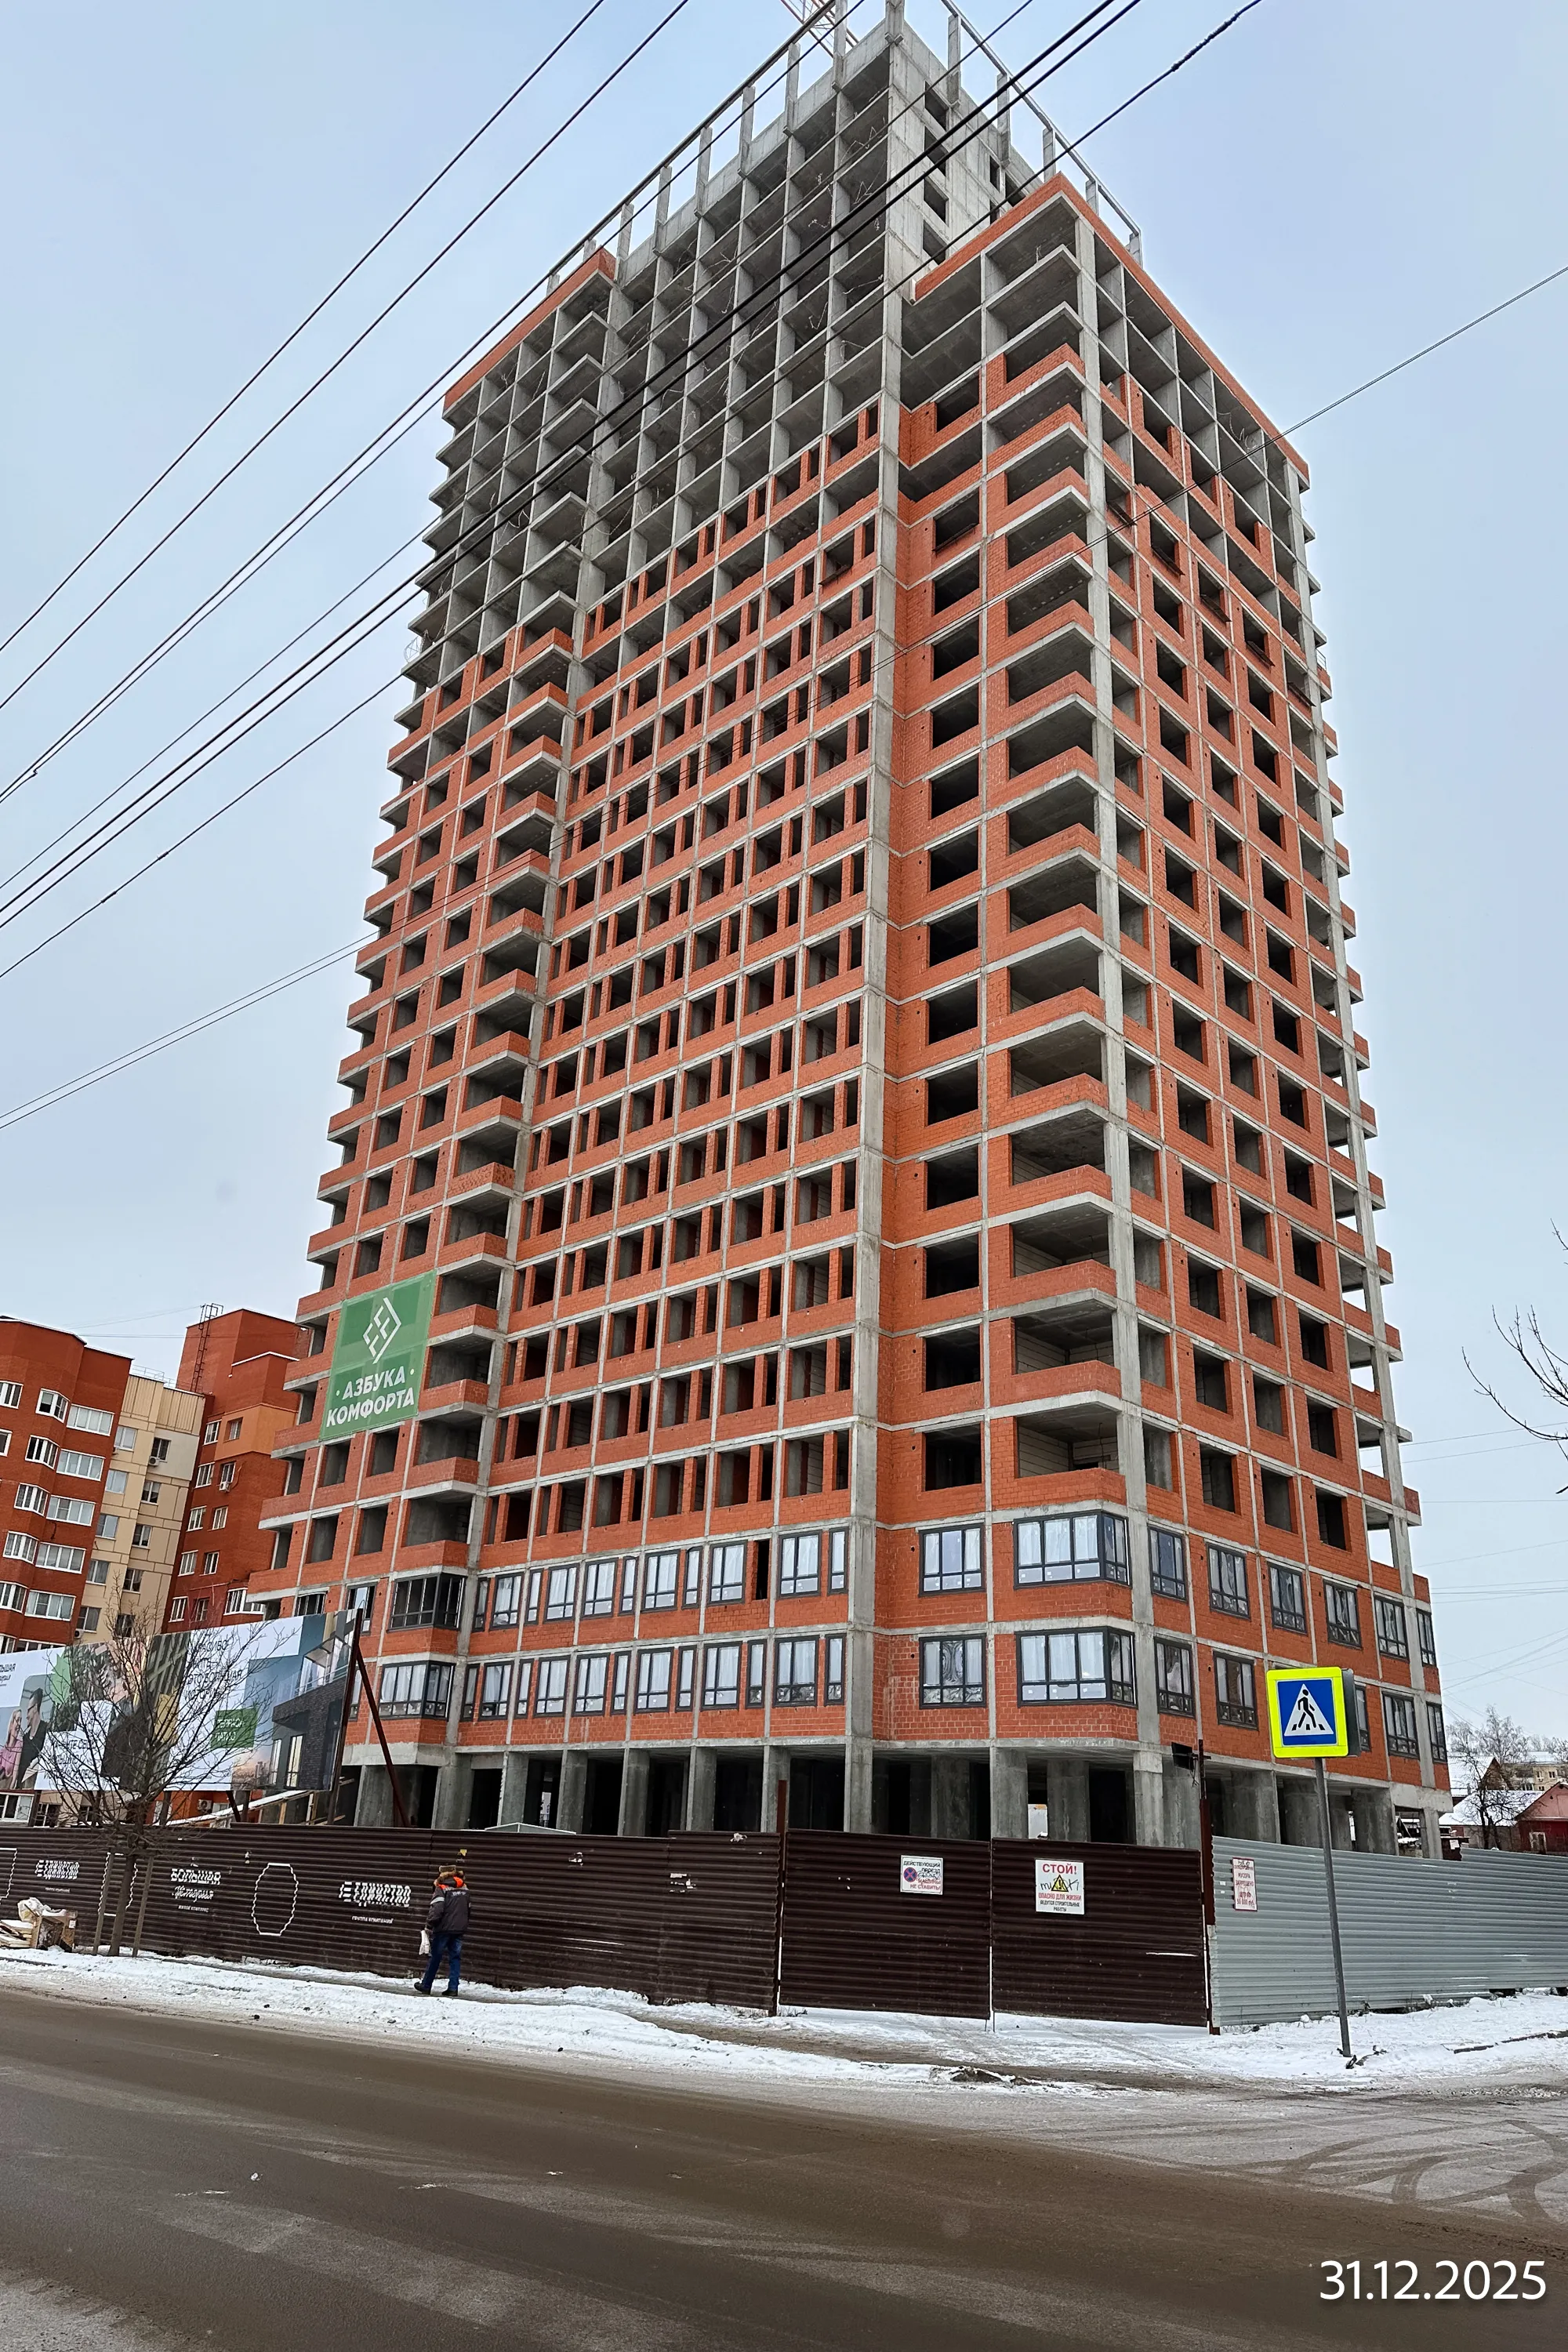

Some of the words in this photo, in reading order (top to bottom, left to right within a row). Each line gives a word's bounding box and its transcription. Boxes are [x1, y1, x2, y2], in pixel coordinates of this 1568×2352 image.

[342, 1366, 405, 1400] АЗБУКА
[326, 1388, 415, 1428] КОМФОРТА
[170, 1868, 221, 1886] БОЛЬШАЯ
[1042, 1863, 1077, 1875] СТОЙ!
